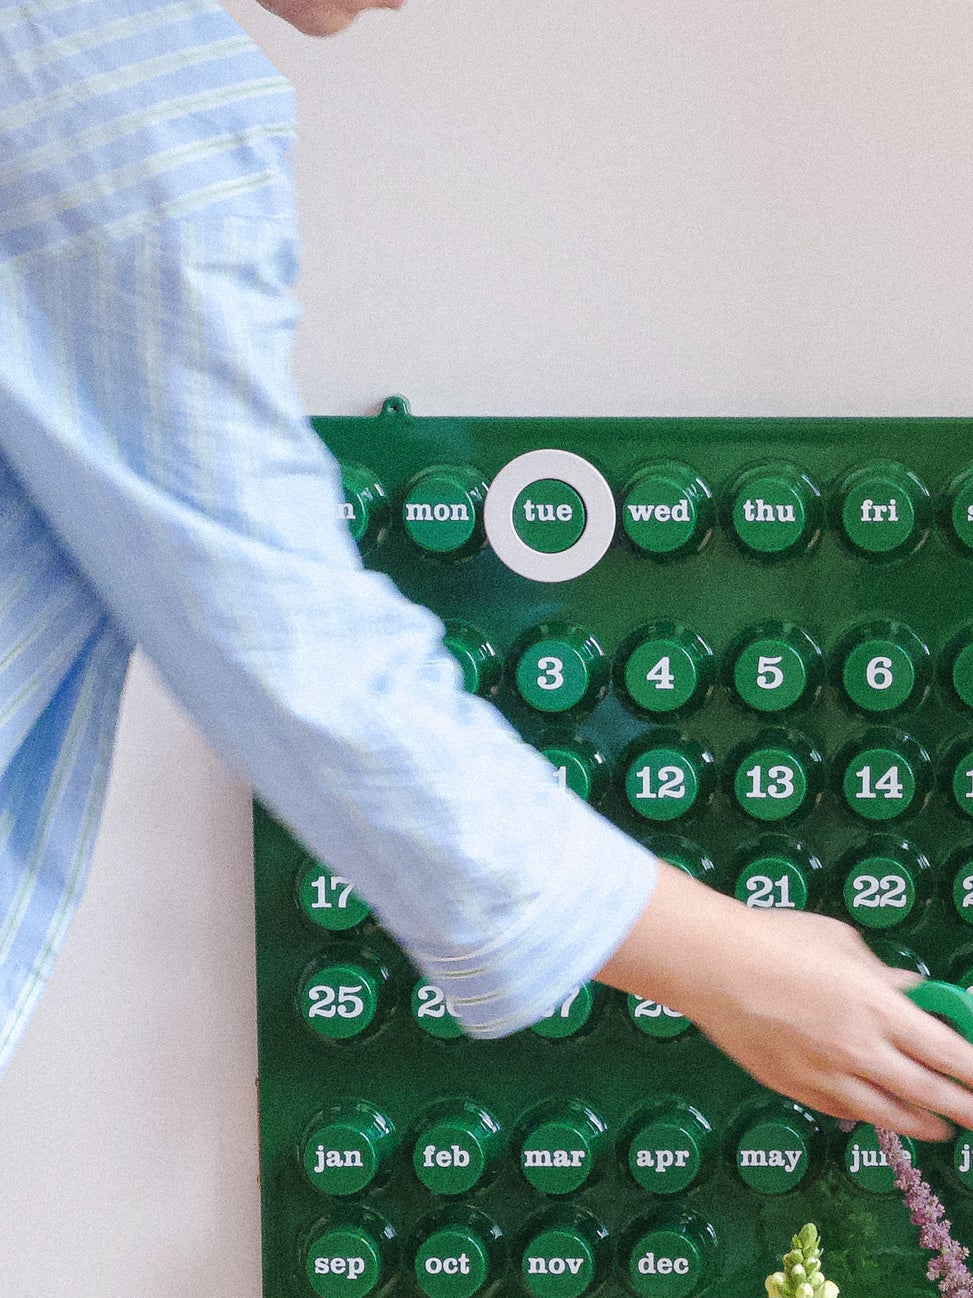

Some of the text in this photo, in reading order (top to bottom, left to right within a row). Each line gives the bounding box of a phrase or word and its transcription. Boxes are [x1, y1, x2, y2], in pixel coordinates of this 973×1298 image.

[406, 503, 469, 522] mon
[523, 499, 572, 522] tue
[628, 499, 690, 522] wed
[743, 499, 795, 522] thu
[861, 499, 898, 522] fri
[536, 657, 563, 689] 3
[646, 657, 674, 689] 4
[756, 657, 783, 689] 5
[866, 657, 893, 689] 6
[636, 766, 686, 799] 12
[746, 766, 794, 799] 13
[855, 766, 903, 799] 14
[311, 876, 354, 908] 17
[746, 875, 795, 908] 21
[853, 875, 906, 907] 22
[308, 985, 363, 1018] 25
[314, 1145, 363, 1172] jan
[423, 1145, 469, 1167] feb
[525, 1149, 585, 1167] mar
[637, 1149, 689, 1172] apr
[741, 1150, 802, 1172] may
[315, 1252, 688, 1279] sep oct nov dec
